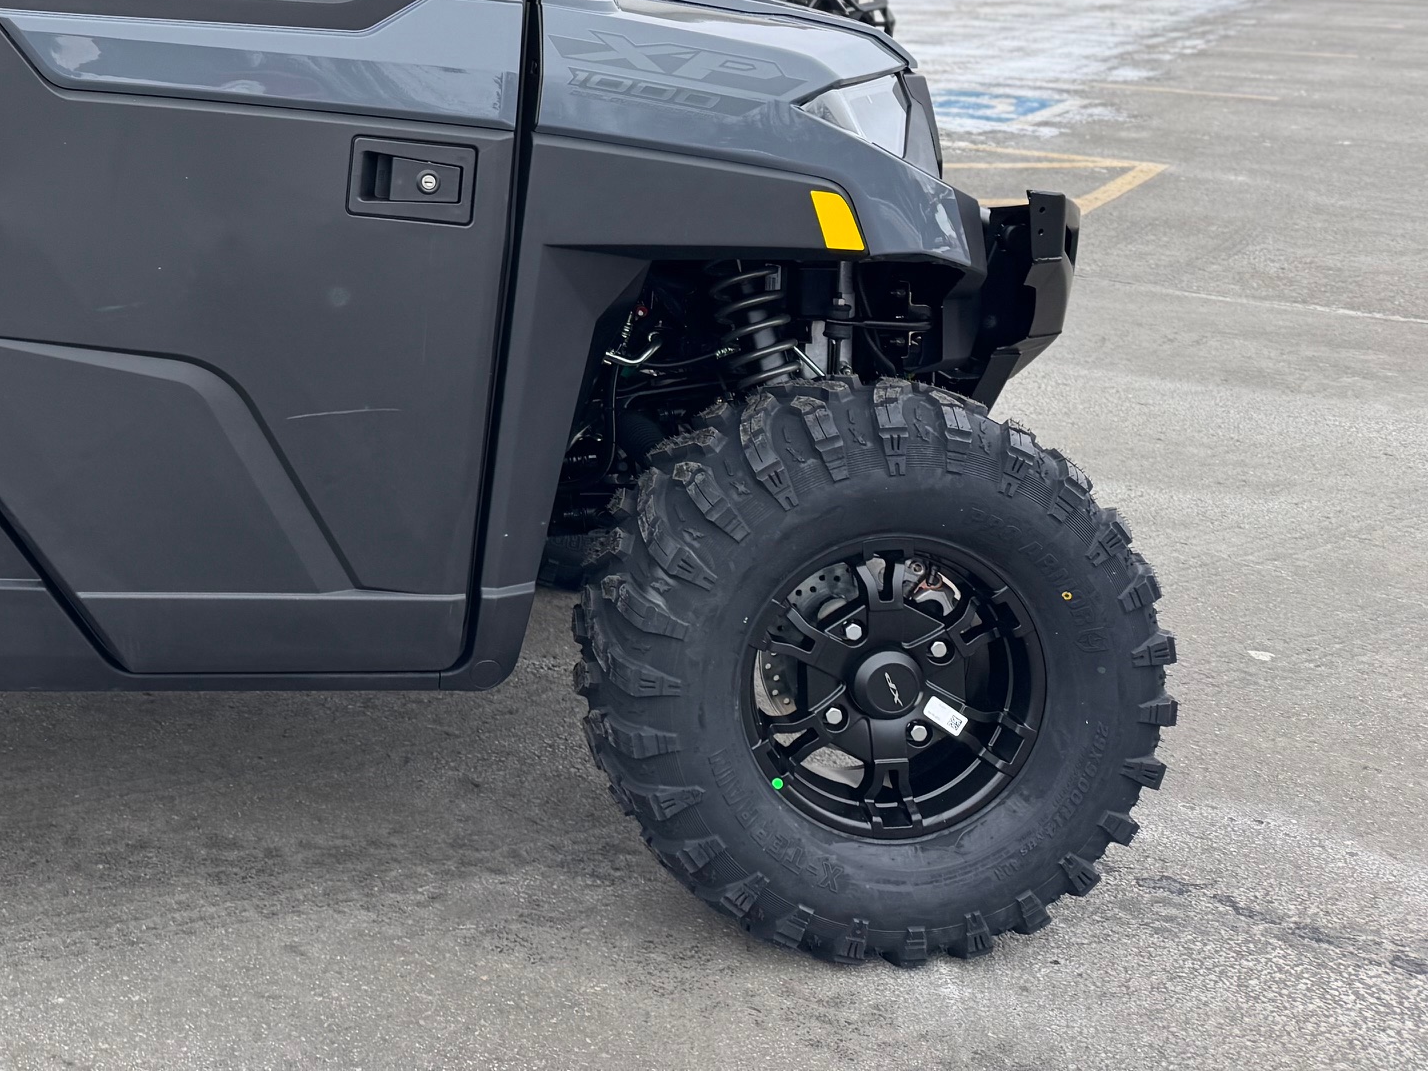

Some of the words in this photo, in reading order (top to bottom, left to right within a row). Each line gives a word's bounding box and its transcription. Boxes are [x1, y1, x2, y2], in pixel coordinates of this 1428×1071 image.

[562, 29, 786, 82] XP
[568, 70, 721, 110] 1000
[884, 671, 904, 707] XP
[707, 748, 845, 894] X-TERRAIN
